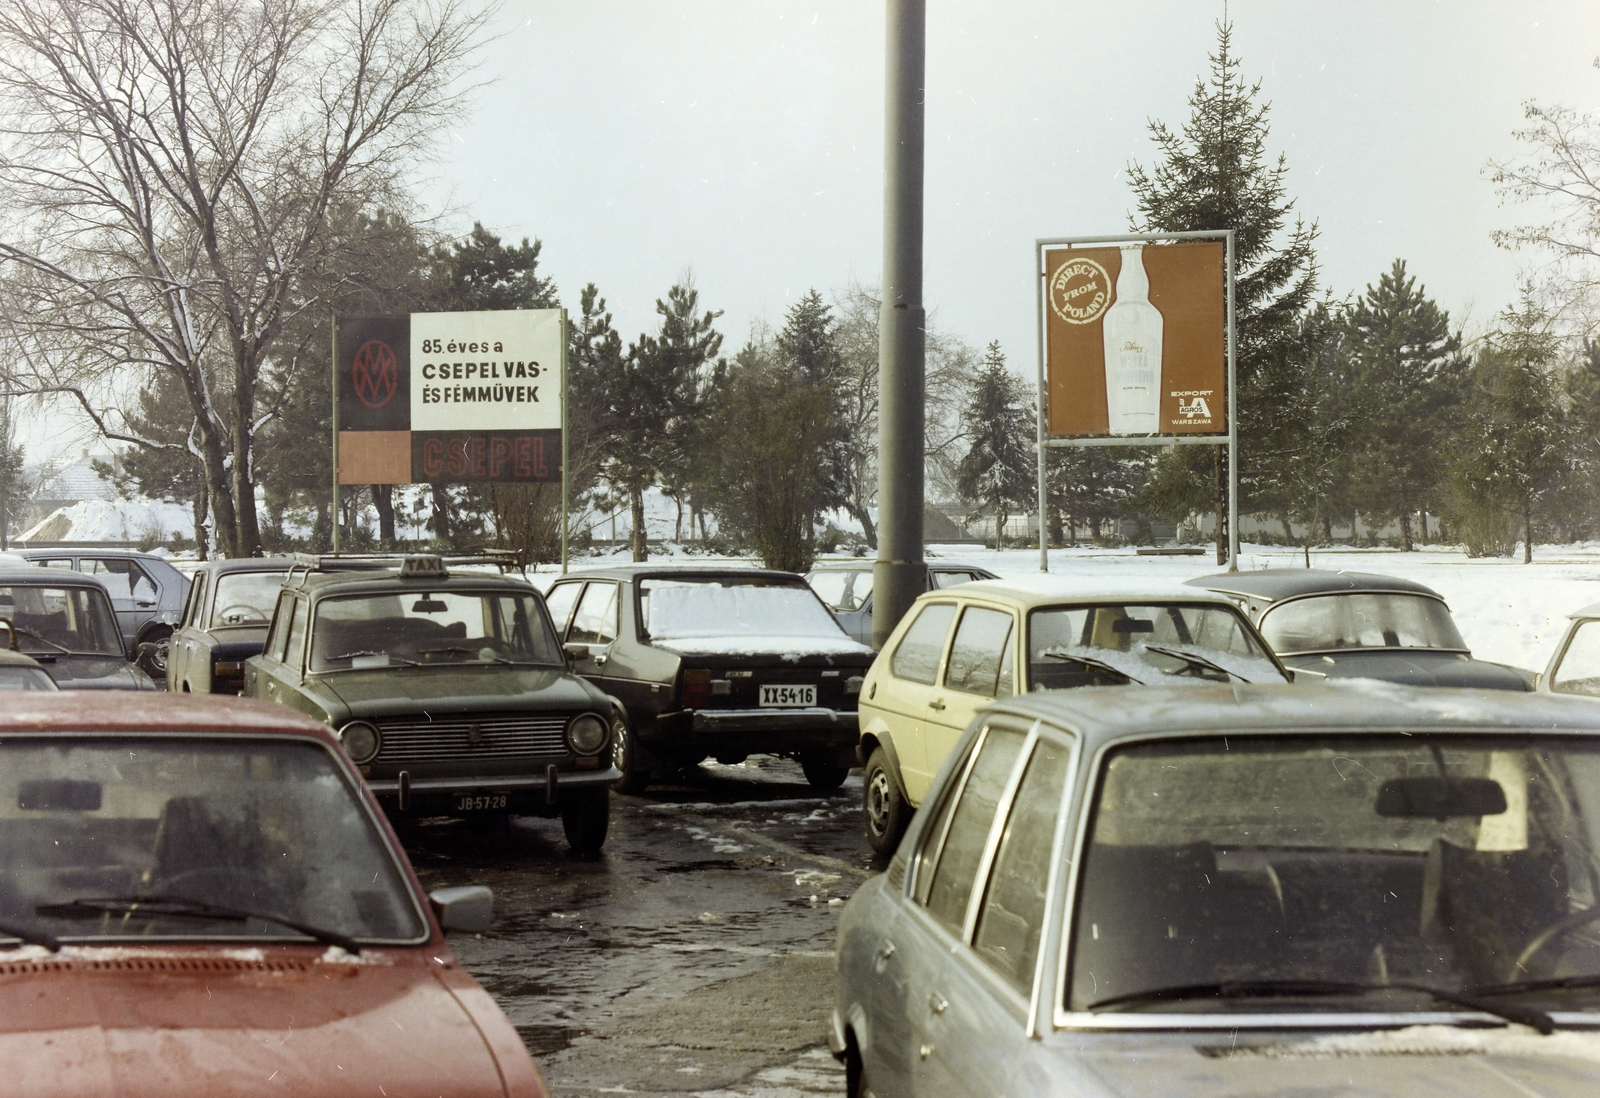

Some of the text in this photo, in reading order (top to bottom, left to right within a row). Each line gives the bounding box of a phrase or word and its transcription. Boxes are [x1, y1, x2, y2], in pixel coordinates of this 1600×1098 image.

[1056, 264, 1098, 290] DIRECT
[1062, 281, 1098, 302] FROM
[1062, 291, 1105, 318] POLAND
[447, 339, 489, 353] éves
[493, 341, 503, 353] a
[422, 361, 548, 379] CSEPEL VAS-
[422, 384, 441, 404] ÉS
[423, 437, 549, 477] CSEPEL
[405, 559, 443, 571] TAXI
